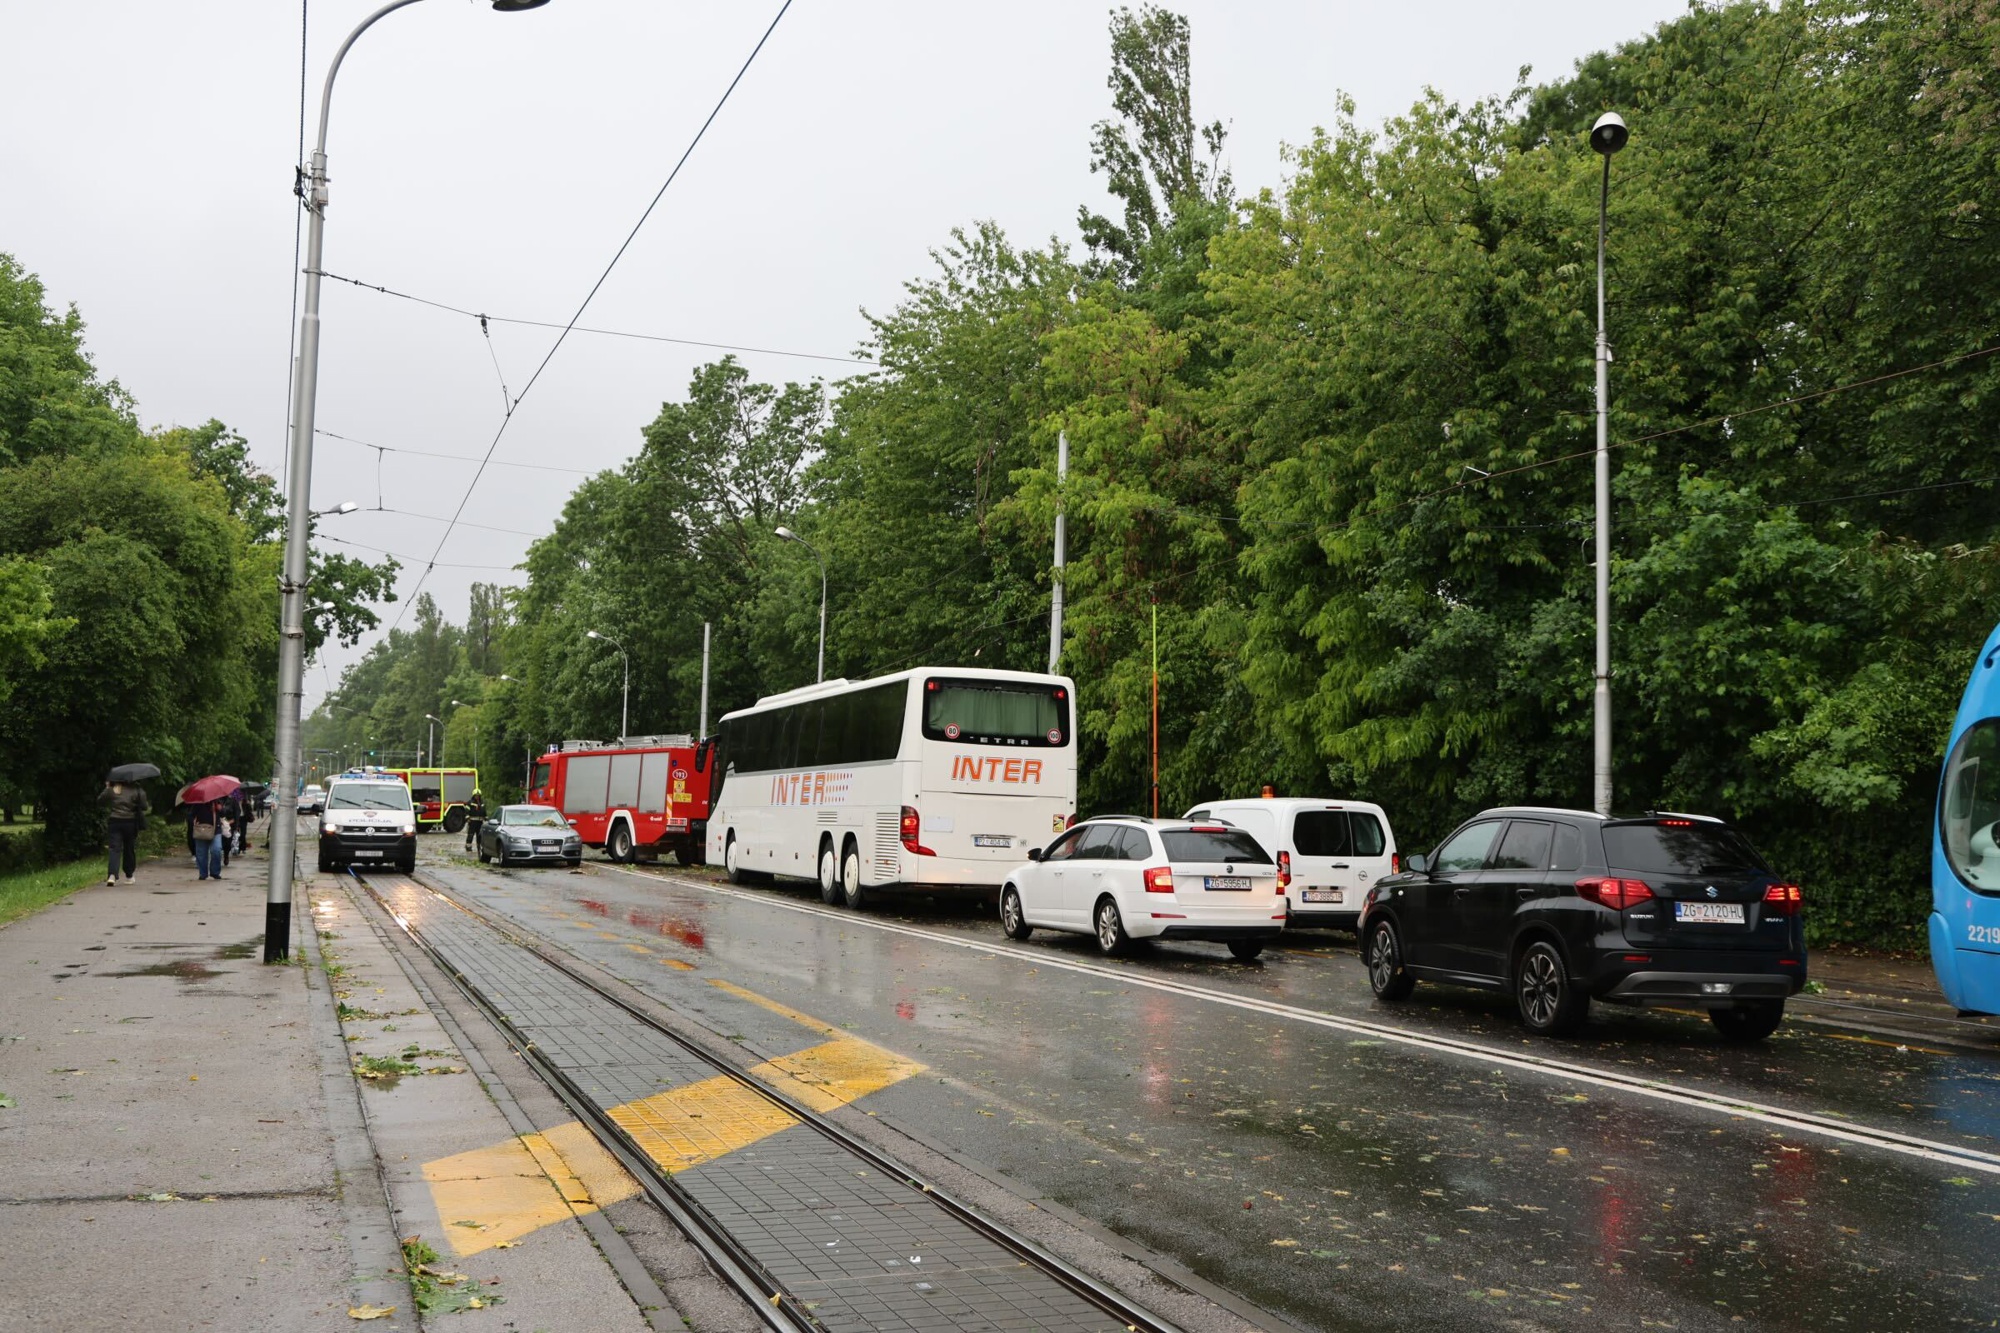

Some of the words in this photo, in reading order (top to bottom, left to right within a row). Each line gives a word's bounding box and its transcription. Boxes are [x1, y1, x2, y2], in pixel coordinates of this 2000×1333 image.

[948, 727, 957, 735] 80
[970, 736, 1029, 745] ETRA
[951, 755, 1043, 784] INTER
[770, 772, 826, 805] INTER
[1210, 877, 1220, 888] ZG
[1682, 904, 1697, 917] ZG
[1968, 925, 2000, 944] 2219
